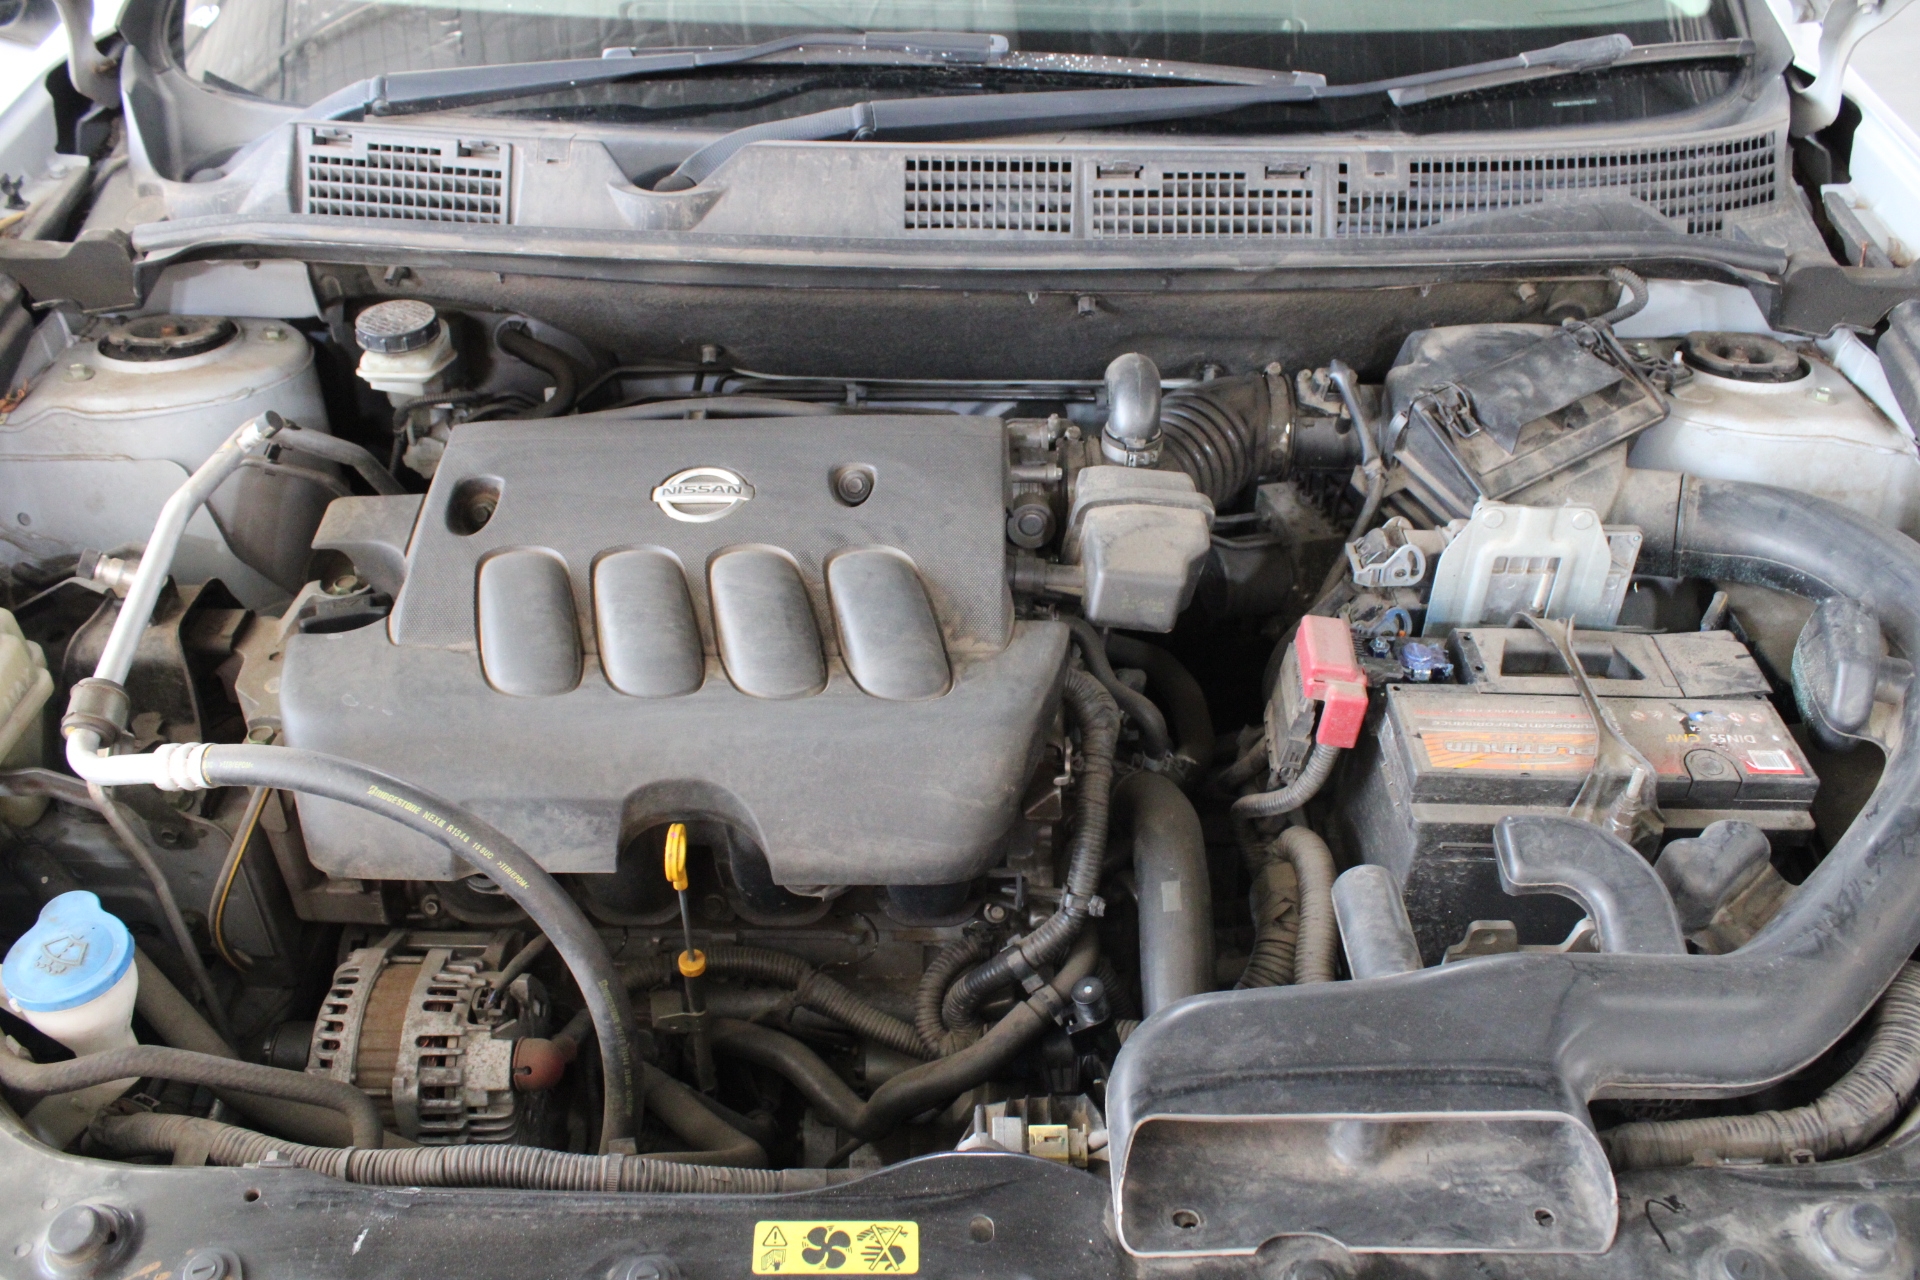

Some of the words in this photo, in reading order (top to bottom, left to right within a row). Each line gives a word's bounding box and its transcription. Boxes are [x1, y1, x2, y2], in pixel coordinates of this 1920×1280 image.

[662, 485, 742, 496] NISSAN
[1444, 740, 1596, 756] PLATINUM
[366, 785, 421, 814] BRIDGESTONE
